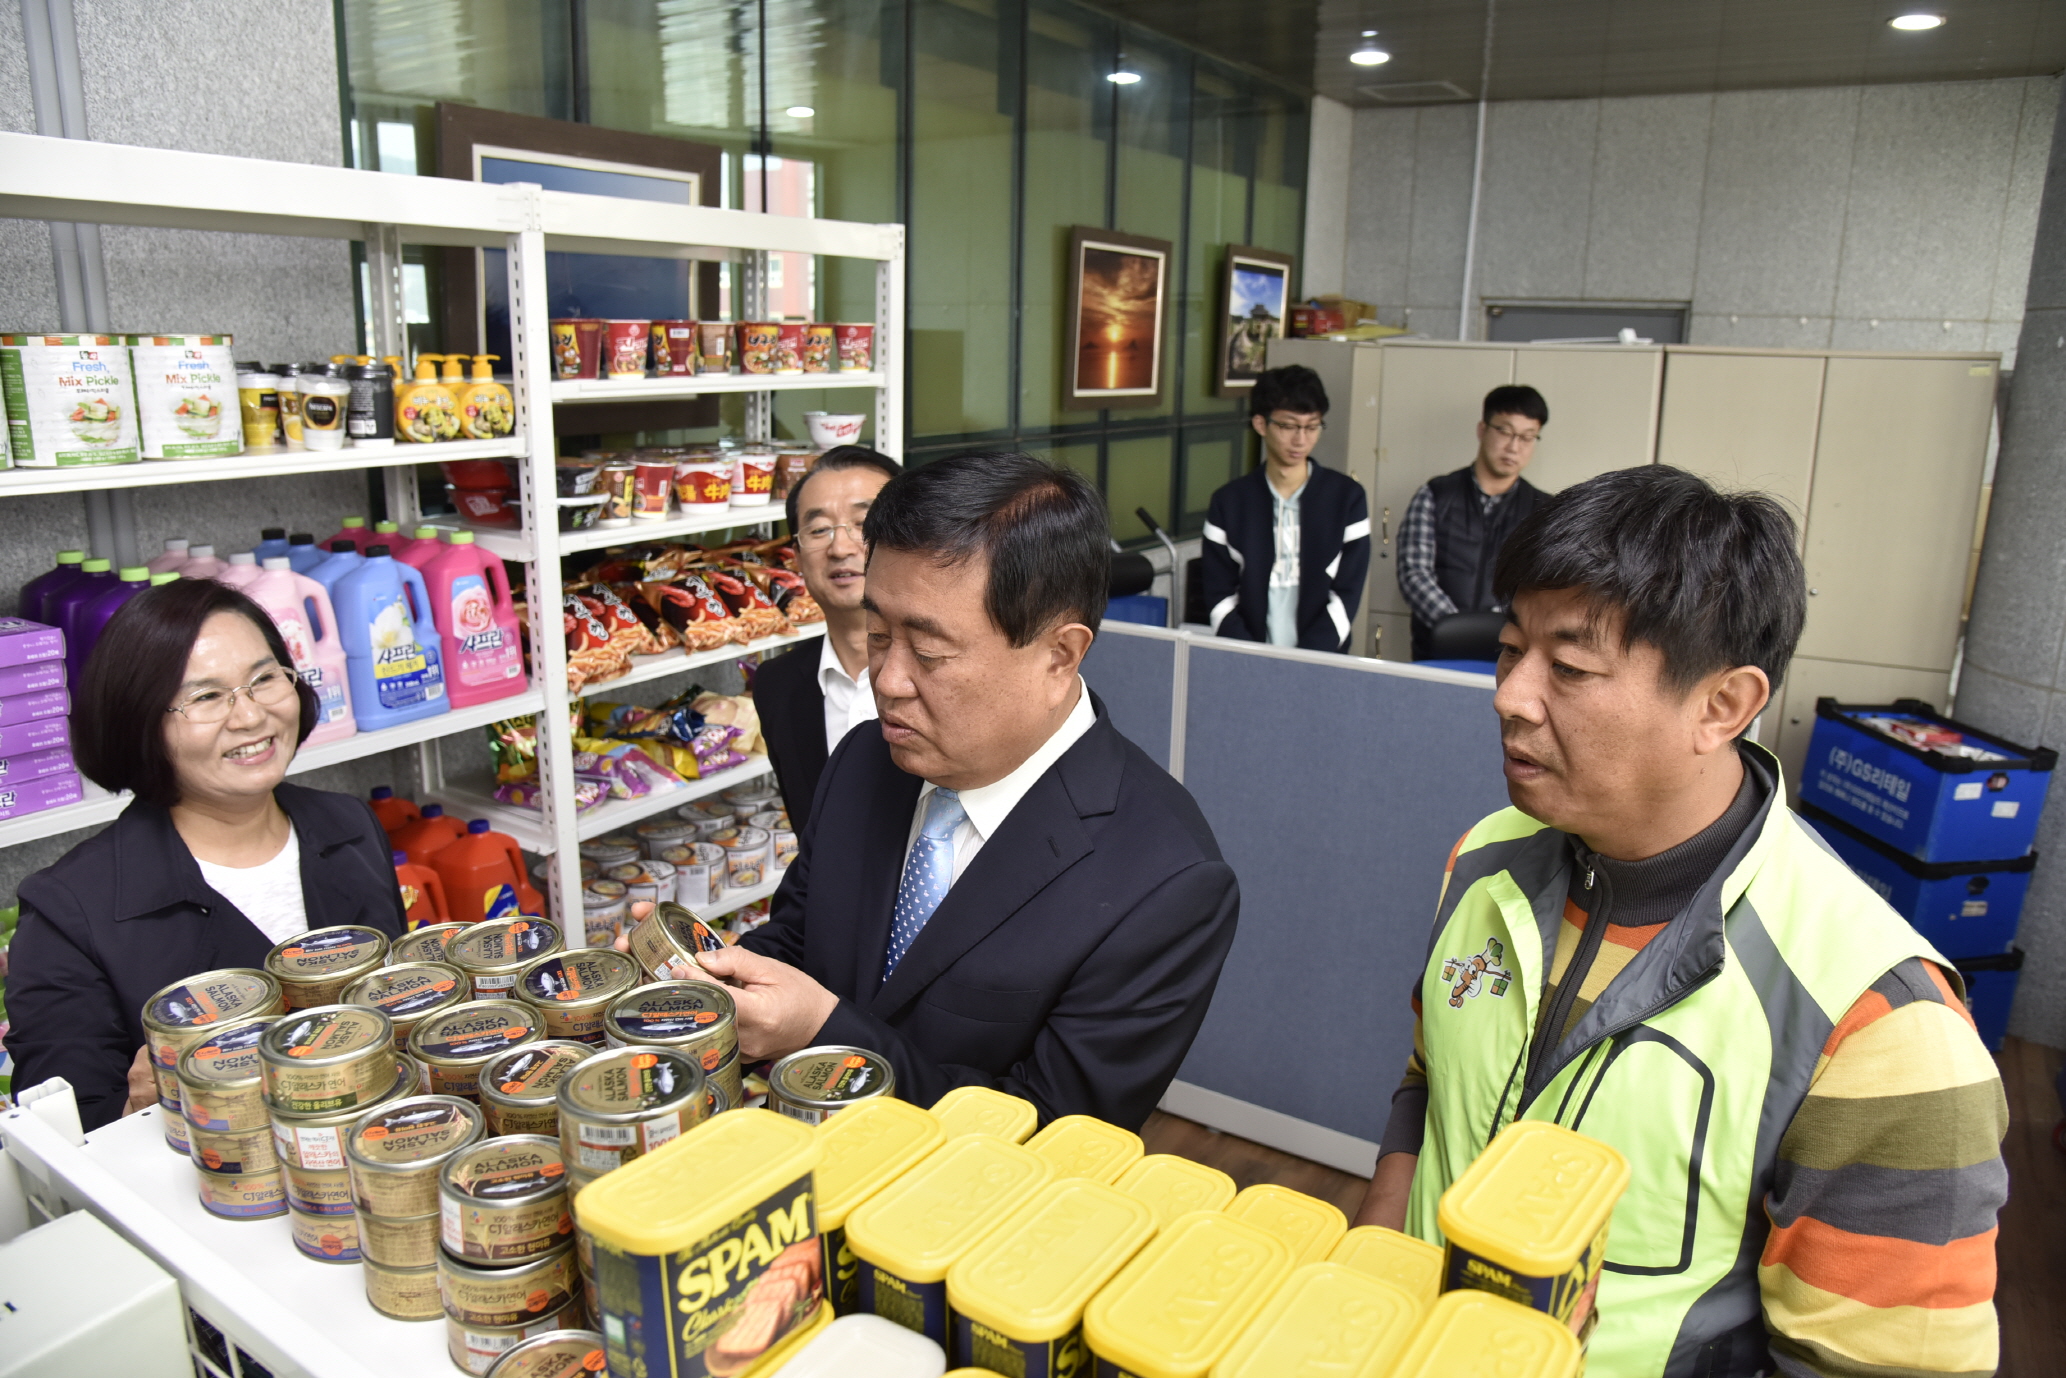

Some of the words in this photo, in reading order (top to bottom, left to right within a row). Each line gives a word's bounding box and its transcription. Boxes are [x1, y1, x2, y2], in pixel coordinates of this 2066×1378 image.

[72, 361, 107, 372] Fresh
[178, 361, 210, 370] Fresh
[59, 377, 83, 386] Mix
[86, 376, 119, 386] Pickle
[165, 374, 187, 384] Mix
[190, 374, 221, 384] Pickle
[297, 949, 359, 964] SALMON
[483, 934, 493, 960] ALASKA
[493, 933, 504, 959] SALMON
[297, 953, 358, 966] ALASKA
[576, 963, 594, 990] SALMON
[587, 961, 604, 987] ALASKA
[205, 985, 233, 1012] SALMON
[215, 983, 243, 1008] ALASKA
[368, 976, 427, 998] ALASKA
[369, 979, 432, 1001] SALMON
[639, 1004, 704, 1012] SALMON
[641, 999, 703, 1007] ALASKA
[440, 1021, 509, 1037] SALMON
[442, 1015, 508, 1032] ALASKA
[574, 1014, 592, 1022] 100%
[321, 1021, 347, 1049] SALMON
[332, 1021, 360, 1049] ALASKA
[532, 1057, 567, 1088] SALMON
[542, 1057, 576, 1088] ALASKA
[803, 1061, 828, 1089] ALASKA
[812, 1062, 838, 1090] SALMON
[604, 1068, 615, 1102] ALASKA
[617, 1067, 628, 1102] SALMON
[383, 1130, 450, 1146] SALMON
[384, 1135, 450, 1151] ALASKA
[474, 1159, 543, 1174] SALMON
[475, 1154, 542, 1168] ALASKA
[500, 1243, 526, 1255] 고소한
[678, 1192, 811, 1314] SPAM
[873, 1268, 906, 1294] SPAM
[1466, 1258, 1513, 1288] SPAM
[971, 1321, 1008, 1348] SPAM
